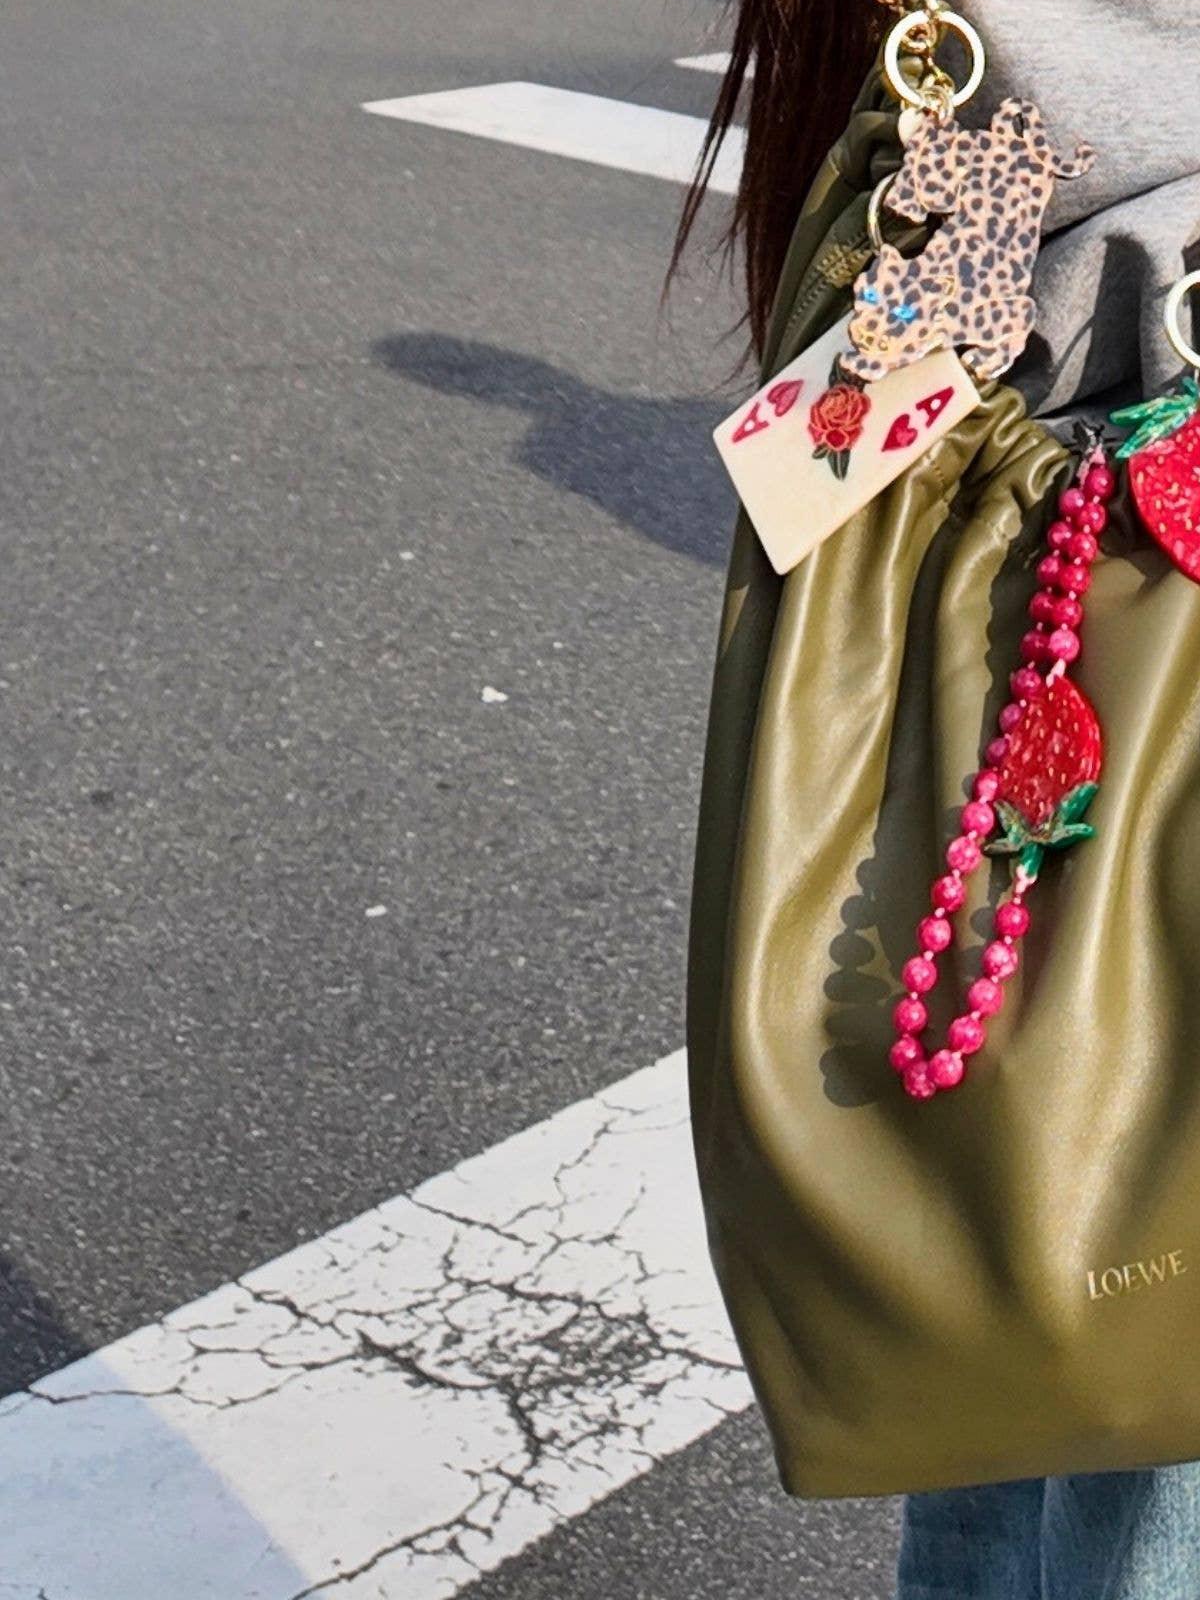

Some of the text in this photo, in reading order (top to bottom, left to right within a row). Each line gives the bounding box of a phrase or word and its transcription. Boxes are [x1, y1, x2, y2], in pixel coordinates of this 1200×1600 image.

[731, 402, 770, 444] A
[915, 385, 956, 429] A
[1087, 1249, 1188, 1301] LOEWE
